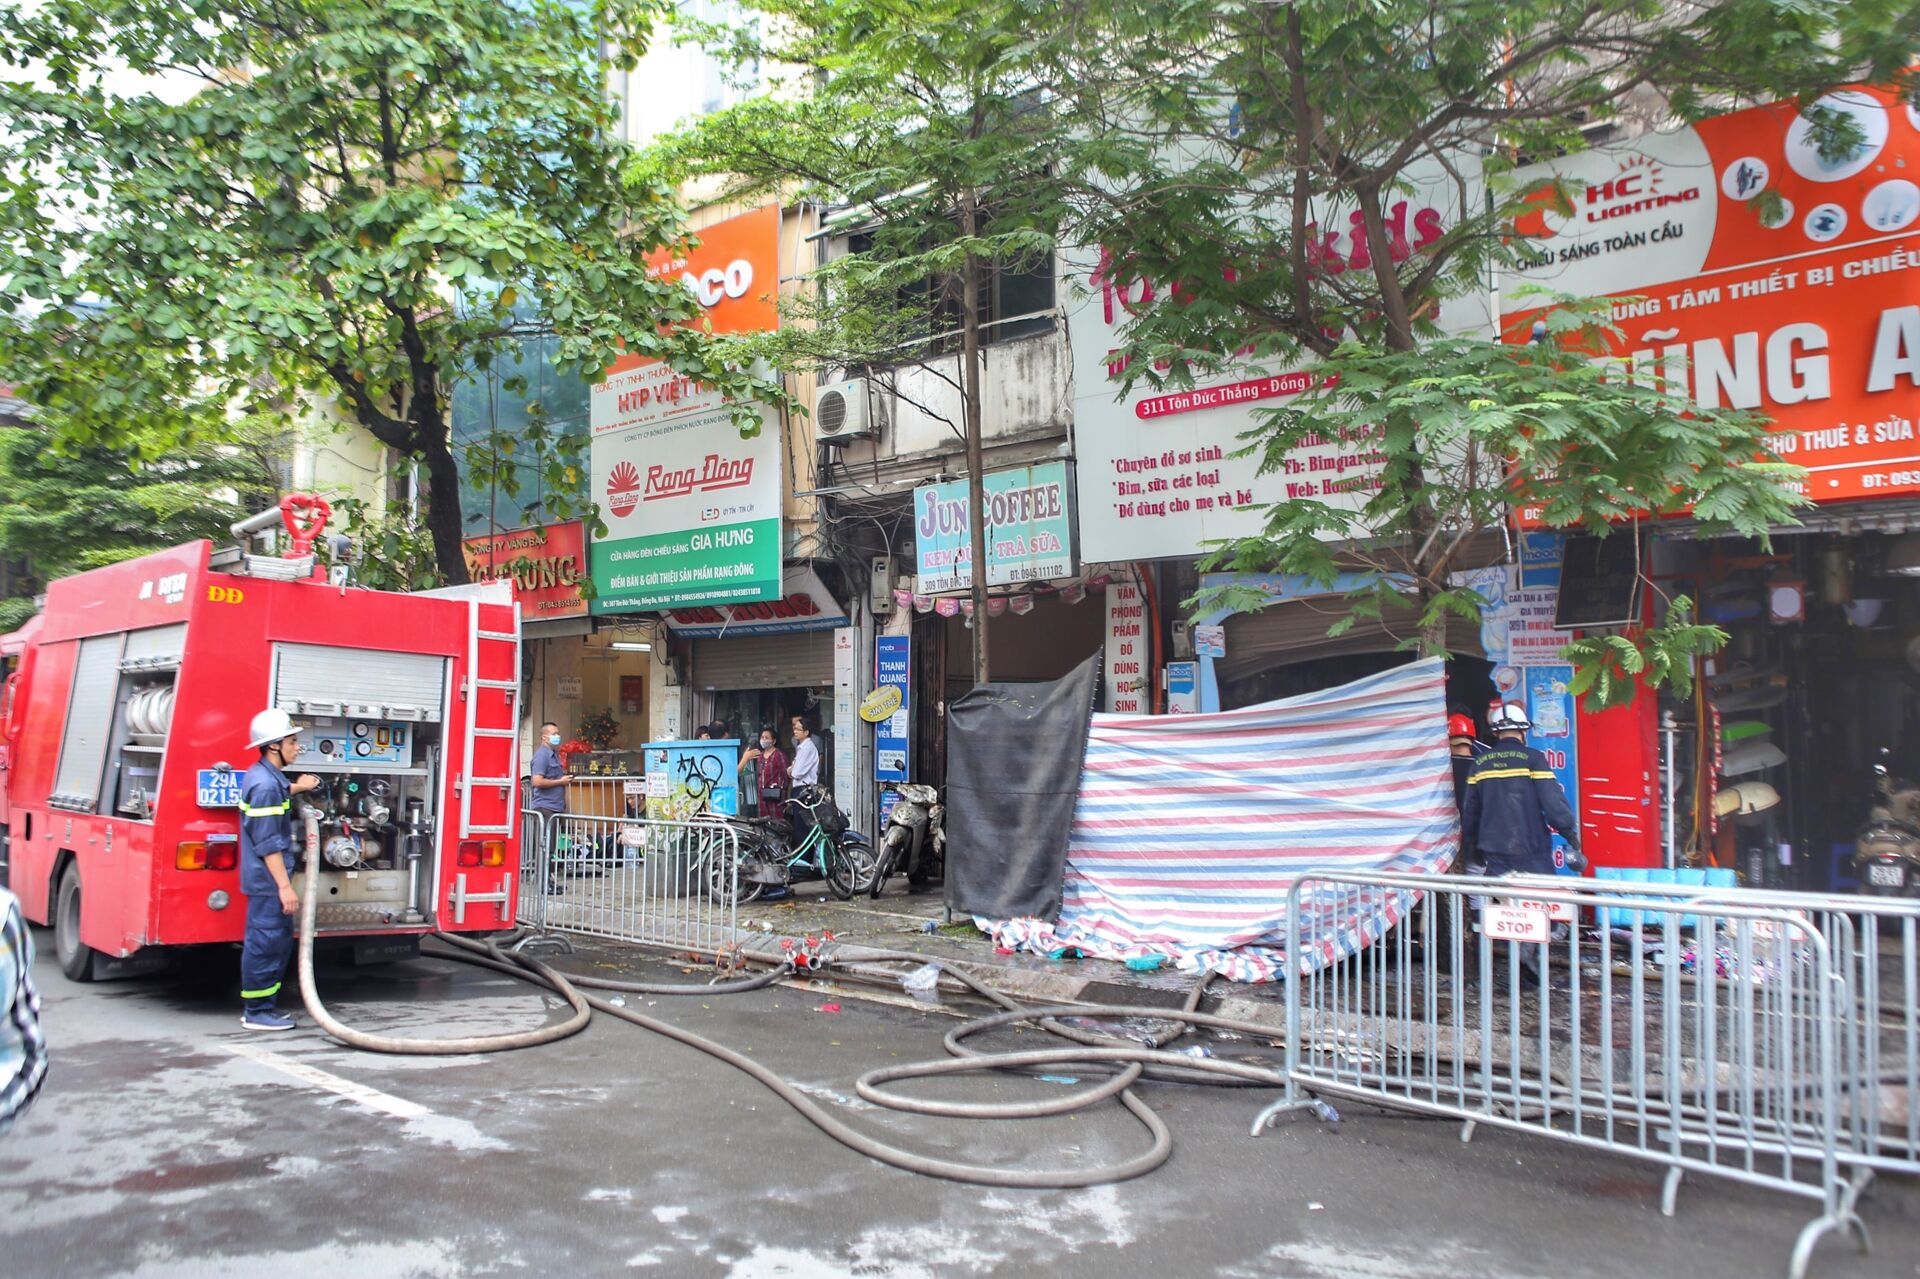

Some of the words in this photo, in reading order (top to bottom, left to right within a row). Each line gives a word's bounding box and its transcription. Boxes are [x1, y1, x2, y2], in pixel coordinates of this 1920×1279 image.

[1586, 174, 1642, 205] HC
[1587, 187, 1699, 223] LIGHTING
[1560, 241, 1600, 262] SÁNG
[1604, 230, 1646, 253] TOÀN
[1651, 220, 1684, 242] CẦU
[1592, 300, 1661, 321] RUNG
[1667, 286, 1721, 311] TÂM
[1727, 267, 1799, 300] THIẾT
[1806, 265, 1835, 287] BỊ
[616, 378, 625, 388] TY
[627, 373, 646, 385] TNHH
[618, 387, 651, 414] HTP
[653, 374, 691, 406] VIỆT
[1143, 402, 1166, 416] 311
[1168, 396, 1190, 410] Tôn
[1193, 393, 1217, 406] Đức
[1219, 384, 1259, 402] Thắng
[1271, 376, 1305, 393] Đống
[1802, 422, 1850, 450] THUÊ
[1854, 424, 1870, 445] &
[1874, 414, 1914, 443] SỬA
[1161, 450, 1175, 467] đồ
[1178, 451, 1191, 465] sơ
[1195, 445, 1222, 462] sinh
[1285, 459, 1305, 474] Fb:
[1148, 478, 1168, 492] sữa
[1172, 475, 1192, 489] các
[1196, 469, 1220, 488] loại
[1286, 481, 1318, 498] Web:
[1137, 501, 1166, 517] dùng
[1169, 497, 1190, 512] cho
[1196, 496, 1214, 512] mẹ
[1218, 491, 1232, 507] và
[1237, 489, 1252, 505] bé
[702, 508, 720, 521] LED
[920, 491, 968, 539] JUN
[623, 550, 640, 560] HÀNG
[672, 543, 689, 554] SÁNG
[691, 533, 713, 550] GIA
[715, 528, 754, 548] HƯNG
[924, 551, 952, 567] KEM
[997, 537, 1026, 557] TRÀ
[1030, 533, 1061, 553] SỮA
[626, 573, 639, 587] BÁN
[640, 574, 645, 586] &
[659, 569, 679, 586] THIỆU
[693, 564, 713, 580] PHẨM
[714, 565, 733, 581] RẠNG
[734, 562, 755, 577] ĐÔNG
[925, 580, 936, 591] 309
[1010, 570, 1021, 580] ĐT:
[1022, 568, 1037, 579] 0945
[1117, 588, 1135, 599] VĂN
[1111, 604, 1142, 618] PHÒNG
[1113, 620, 1140, 637] PHẨM
[880, 661, 906, 671] THANH
[1114, 661, 1139, 674] DÙNG
[879, 674, 907, 683] QUANG
[868, 704, 882, 718] SIM
[1115, 700, 1137, 712] SINH
[209, 772, 237, 788] 29A
[200, 788, 242, 804] 021.5
[1501, 911, 1528, 919] POLICE
[1497, 921, 1534, 934] STOP
